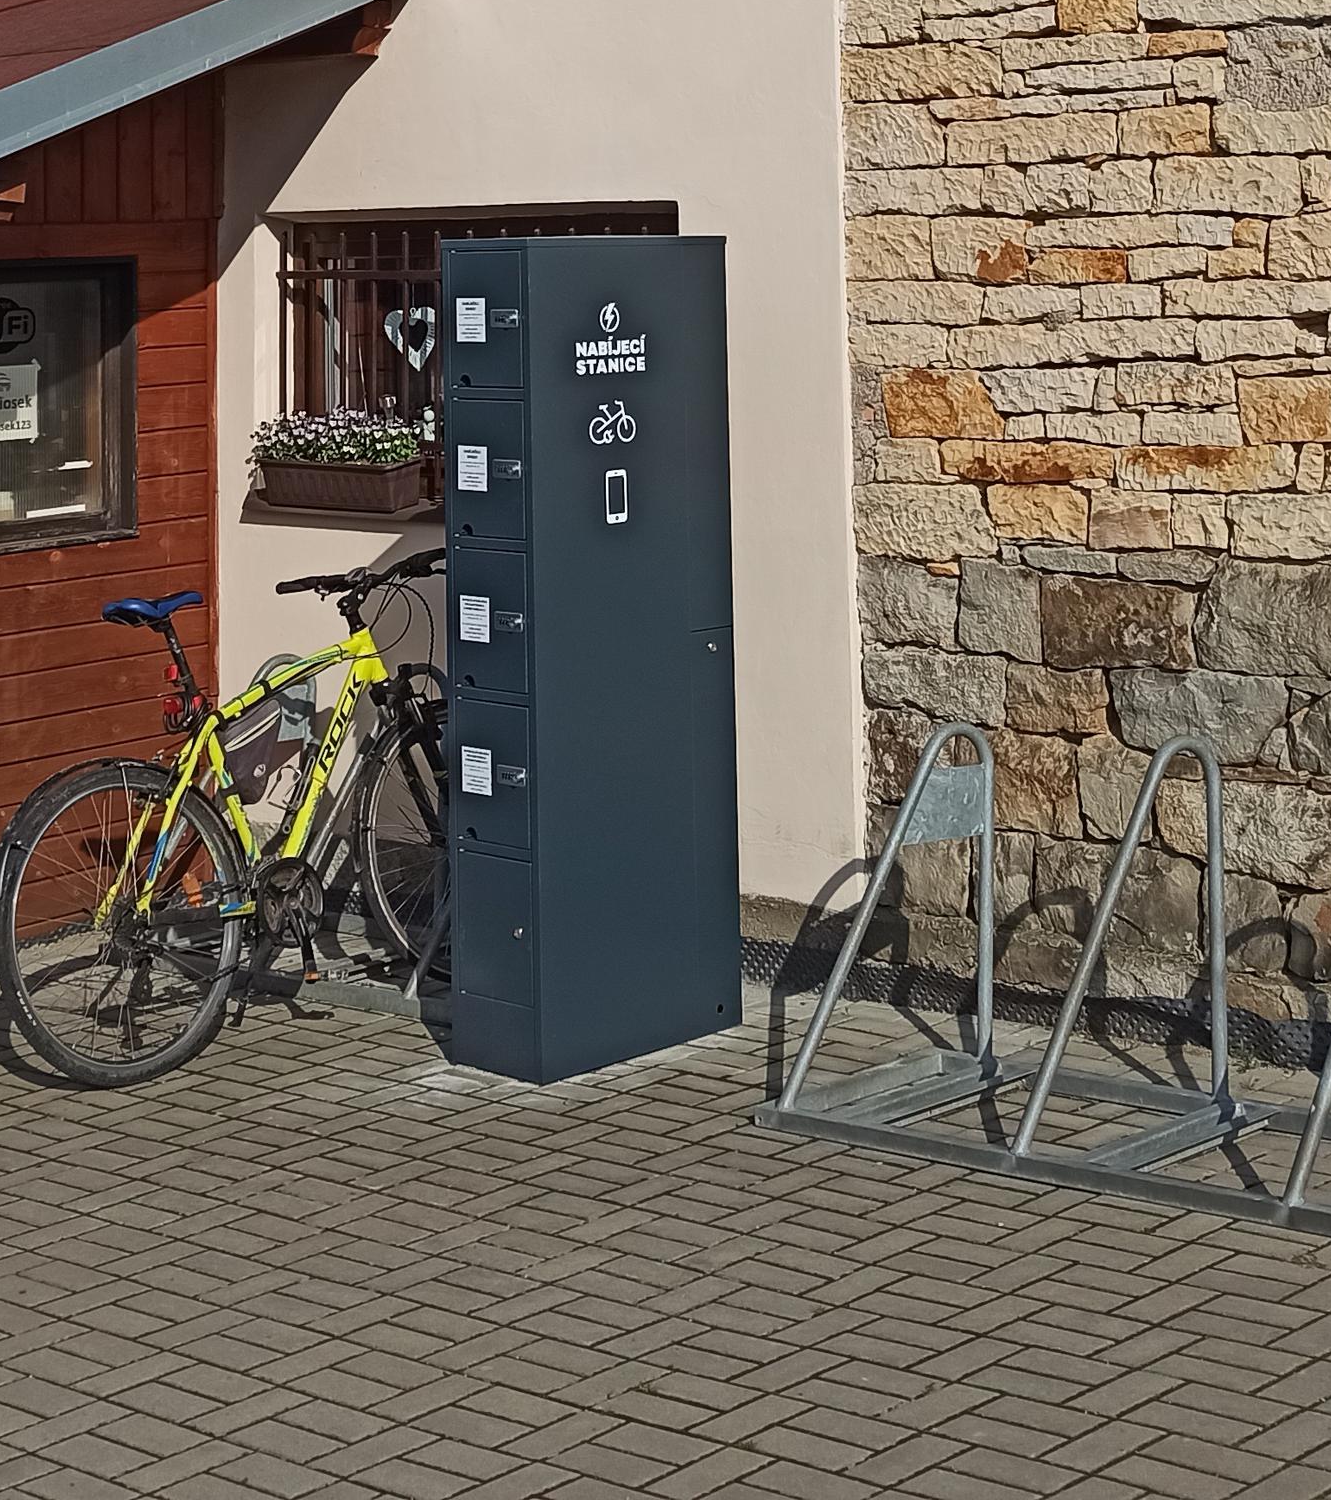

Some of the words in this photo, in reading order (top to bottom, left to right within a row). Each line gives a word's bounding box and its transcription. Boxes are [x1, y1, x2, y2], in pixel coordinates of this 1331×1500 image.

[575, 334, 646, 357] NABÍJECÍ
[576, 357, 646, 375] STANICE
[318, 671, 363, 773] ROCK
